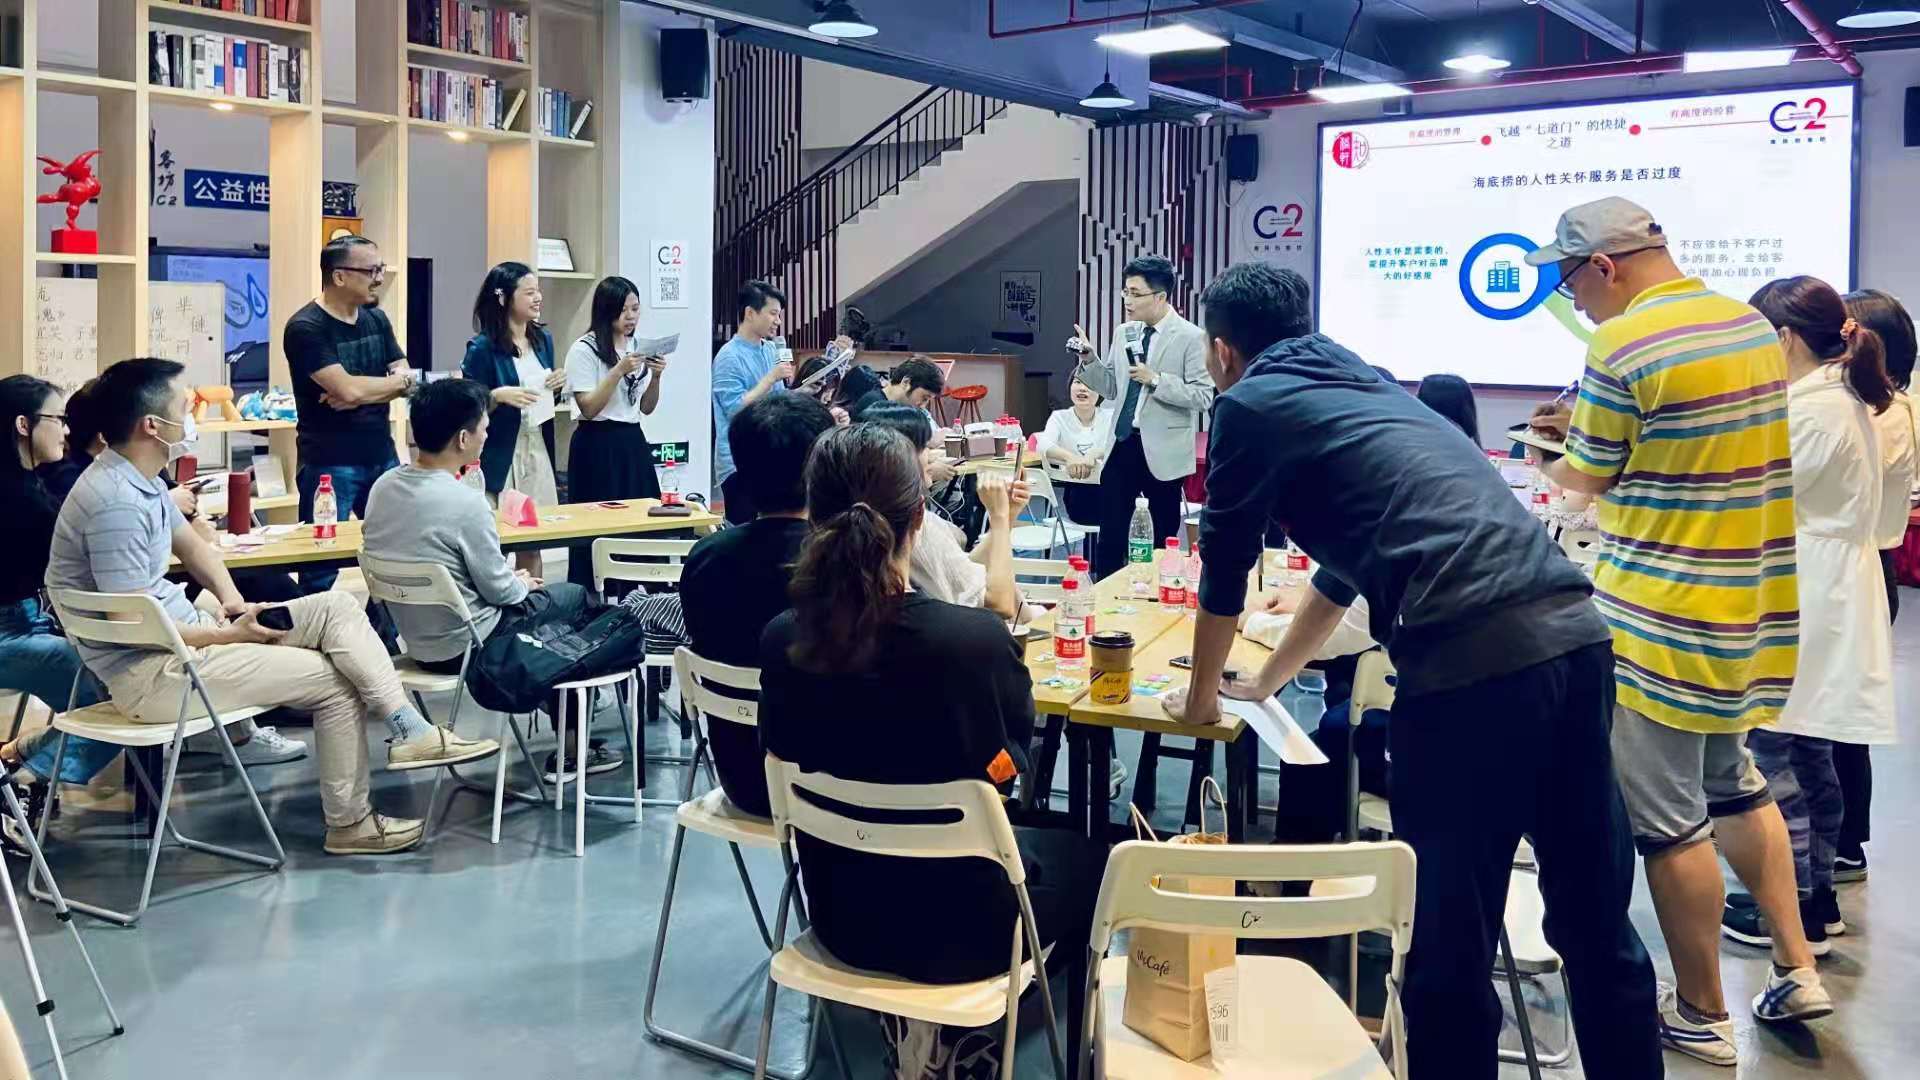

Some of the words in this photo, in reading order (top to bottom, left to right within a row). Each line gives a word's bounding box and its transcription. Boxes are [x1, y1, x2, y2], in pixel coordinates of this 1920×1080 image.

[1769, 97, 1827, 133] C2
[1547, 136, 1572, 149] 之道
[1473, 166, 1682, 190] 海底捞的人性关怀服务是否过度
[1253, 203, 1303, 239] C2
[658, 245, 682, 265] C2
